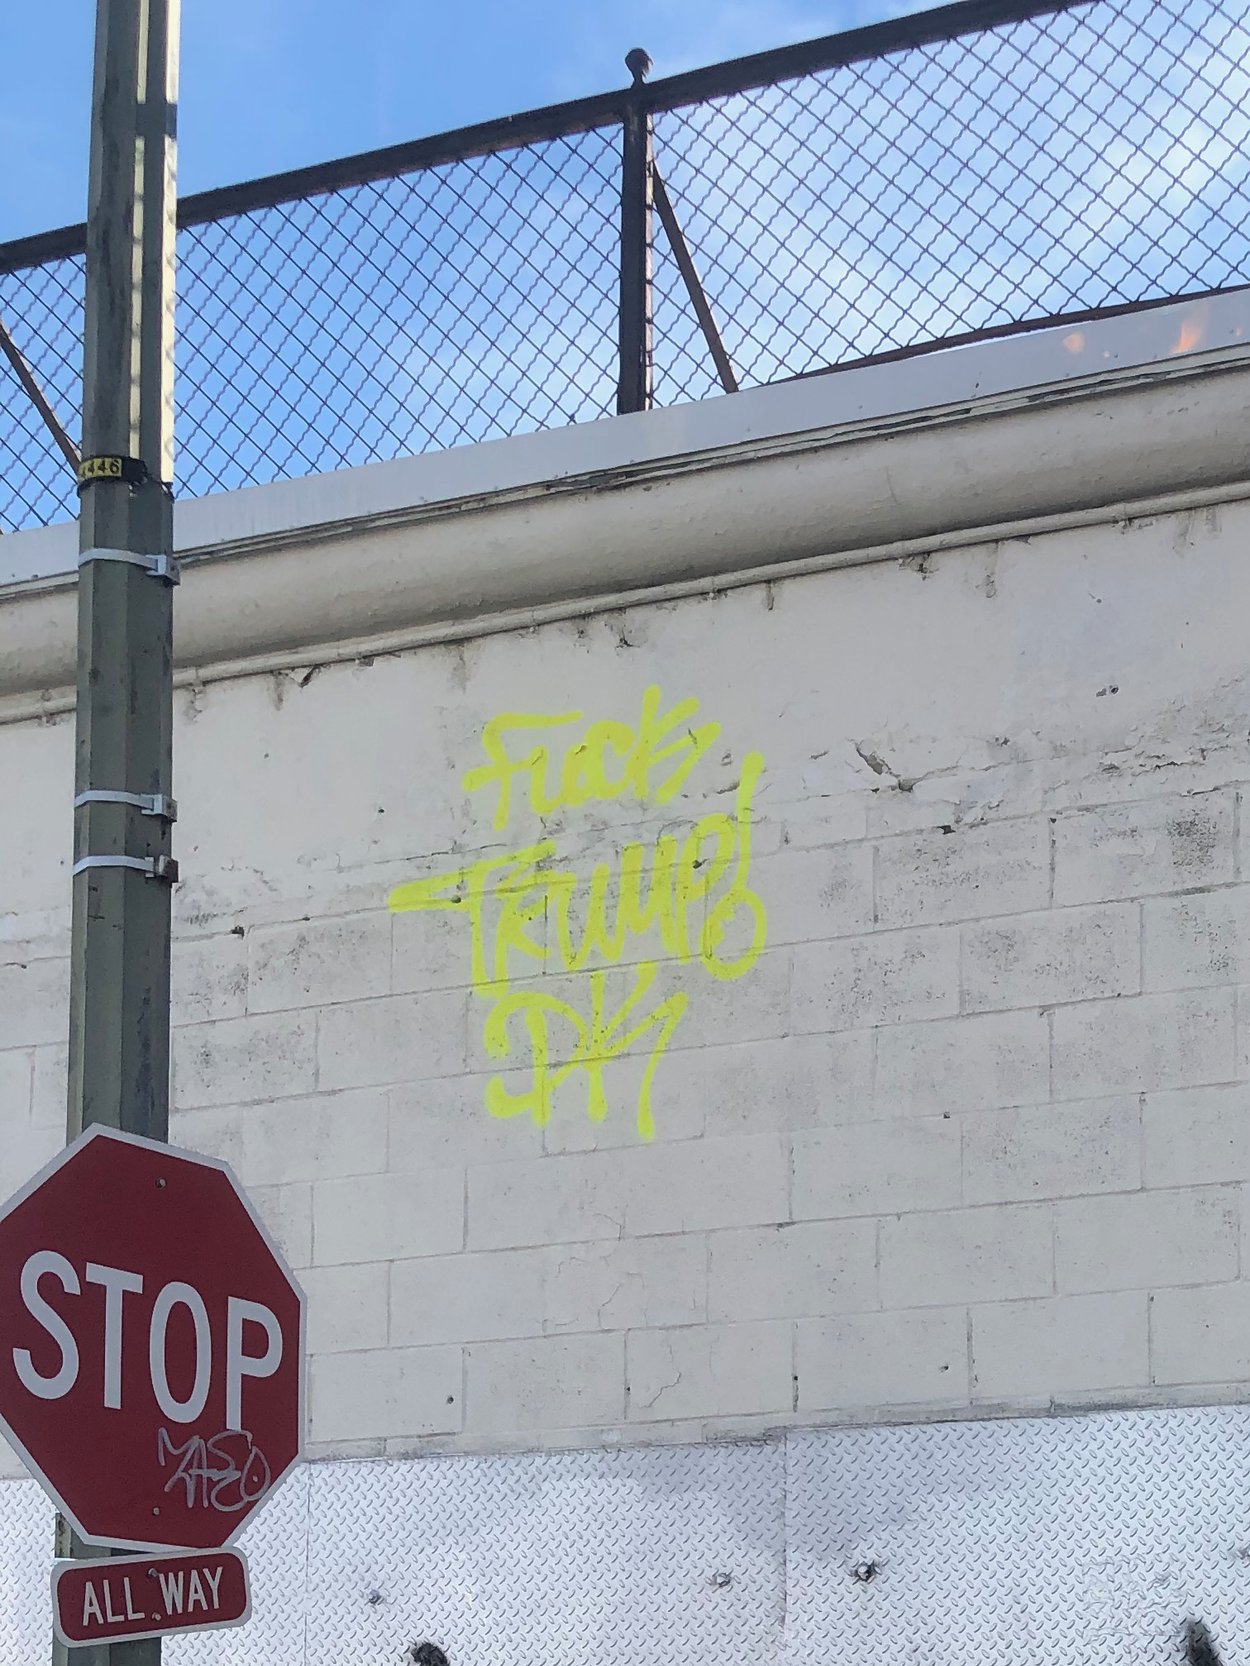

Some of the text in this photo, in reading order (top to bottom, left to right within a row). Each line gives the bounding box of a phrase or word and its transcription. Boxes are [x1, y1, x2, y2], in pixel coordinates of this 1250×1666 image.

[12, 1250, 283, 1431] STOP
[82, 1566, 223, 1627] ALL WAY
